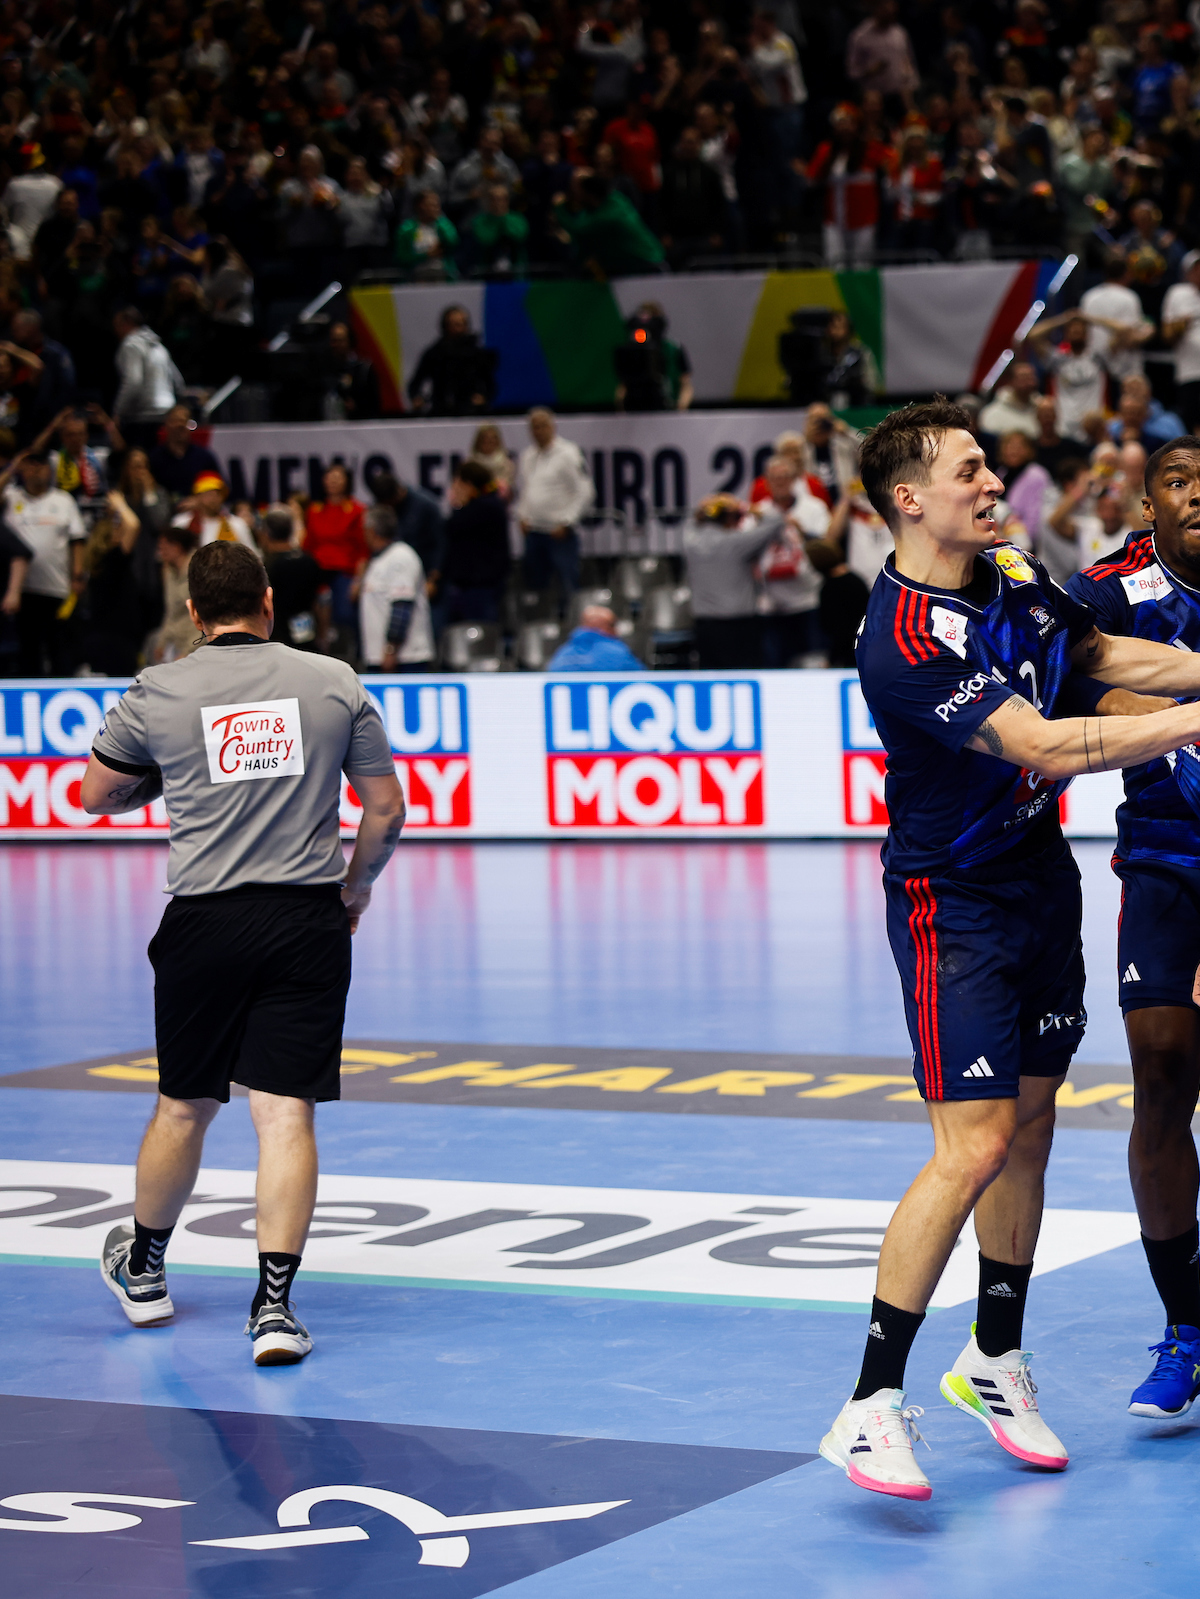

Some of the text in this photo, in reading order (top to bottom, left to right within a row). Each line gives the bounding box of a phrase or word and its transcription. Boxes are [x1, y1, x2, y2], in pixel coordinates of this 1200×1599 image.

[211, 710, 285, 743] Town &
[551, 683, 755, 755] LIQUI
[219, 735, 294, 774] Country
[244, 757, 279, 772] HAUS
[552, 756, 763, 826] MOLY
[987, 1288, 1018, 1299] adidas
